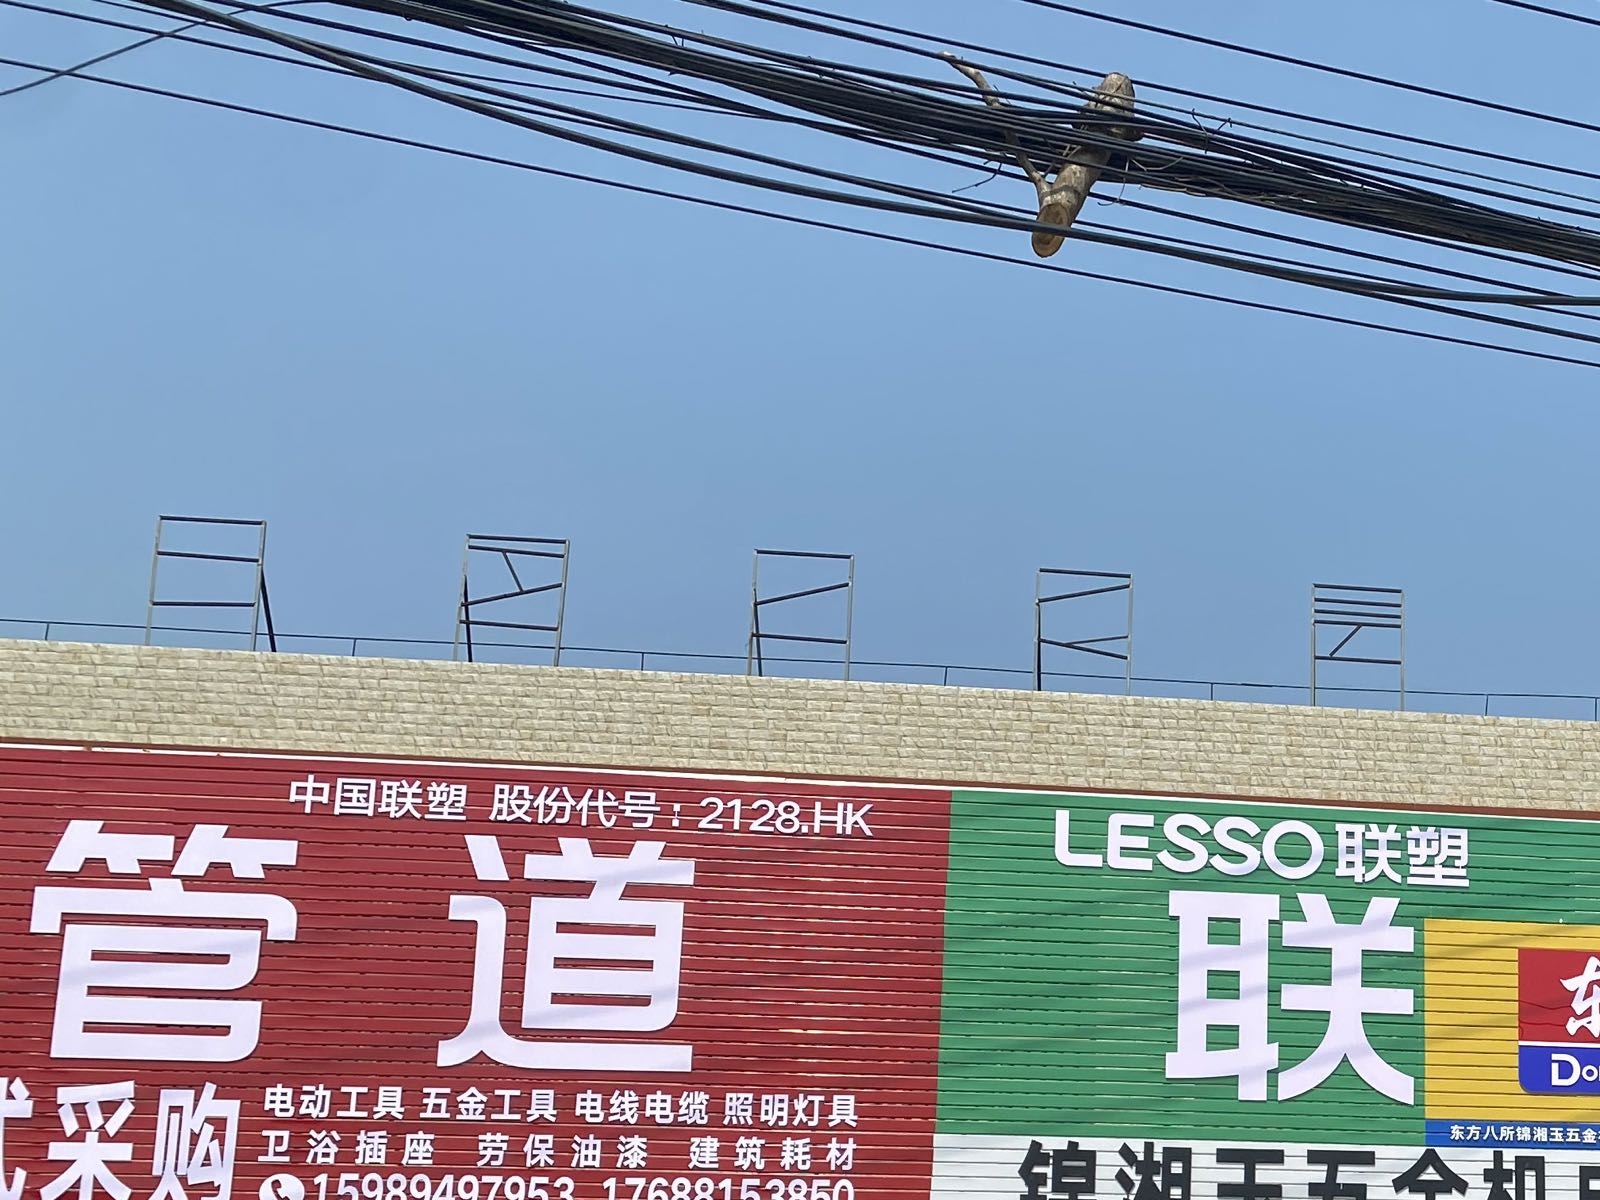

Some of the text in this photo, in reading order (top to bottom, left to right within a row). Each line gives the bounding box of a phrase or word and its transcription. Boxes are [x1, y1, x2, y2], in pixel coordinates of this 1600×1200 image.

[288, 773, 467, 821] 中国联塑
[1165, 889, 1416, 1106] 联
[264, 1083, 858, 1128] 电动工具 五金工具 电线电缆 照明灯具
[257, 1129, 857, 1171] 卫浴插座 劳保油漆 建筑耗材
